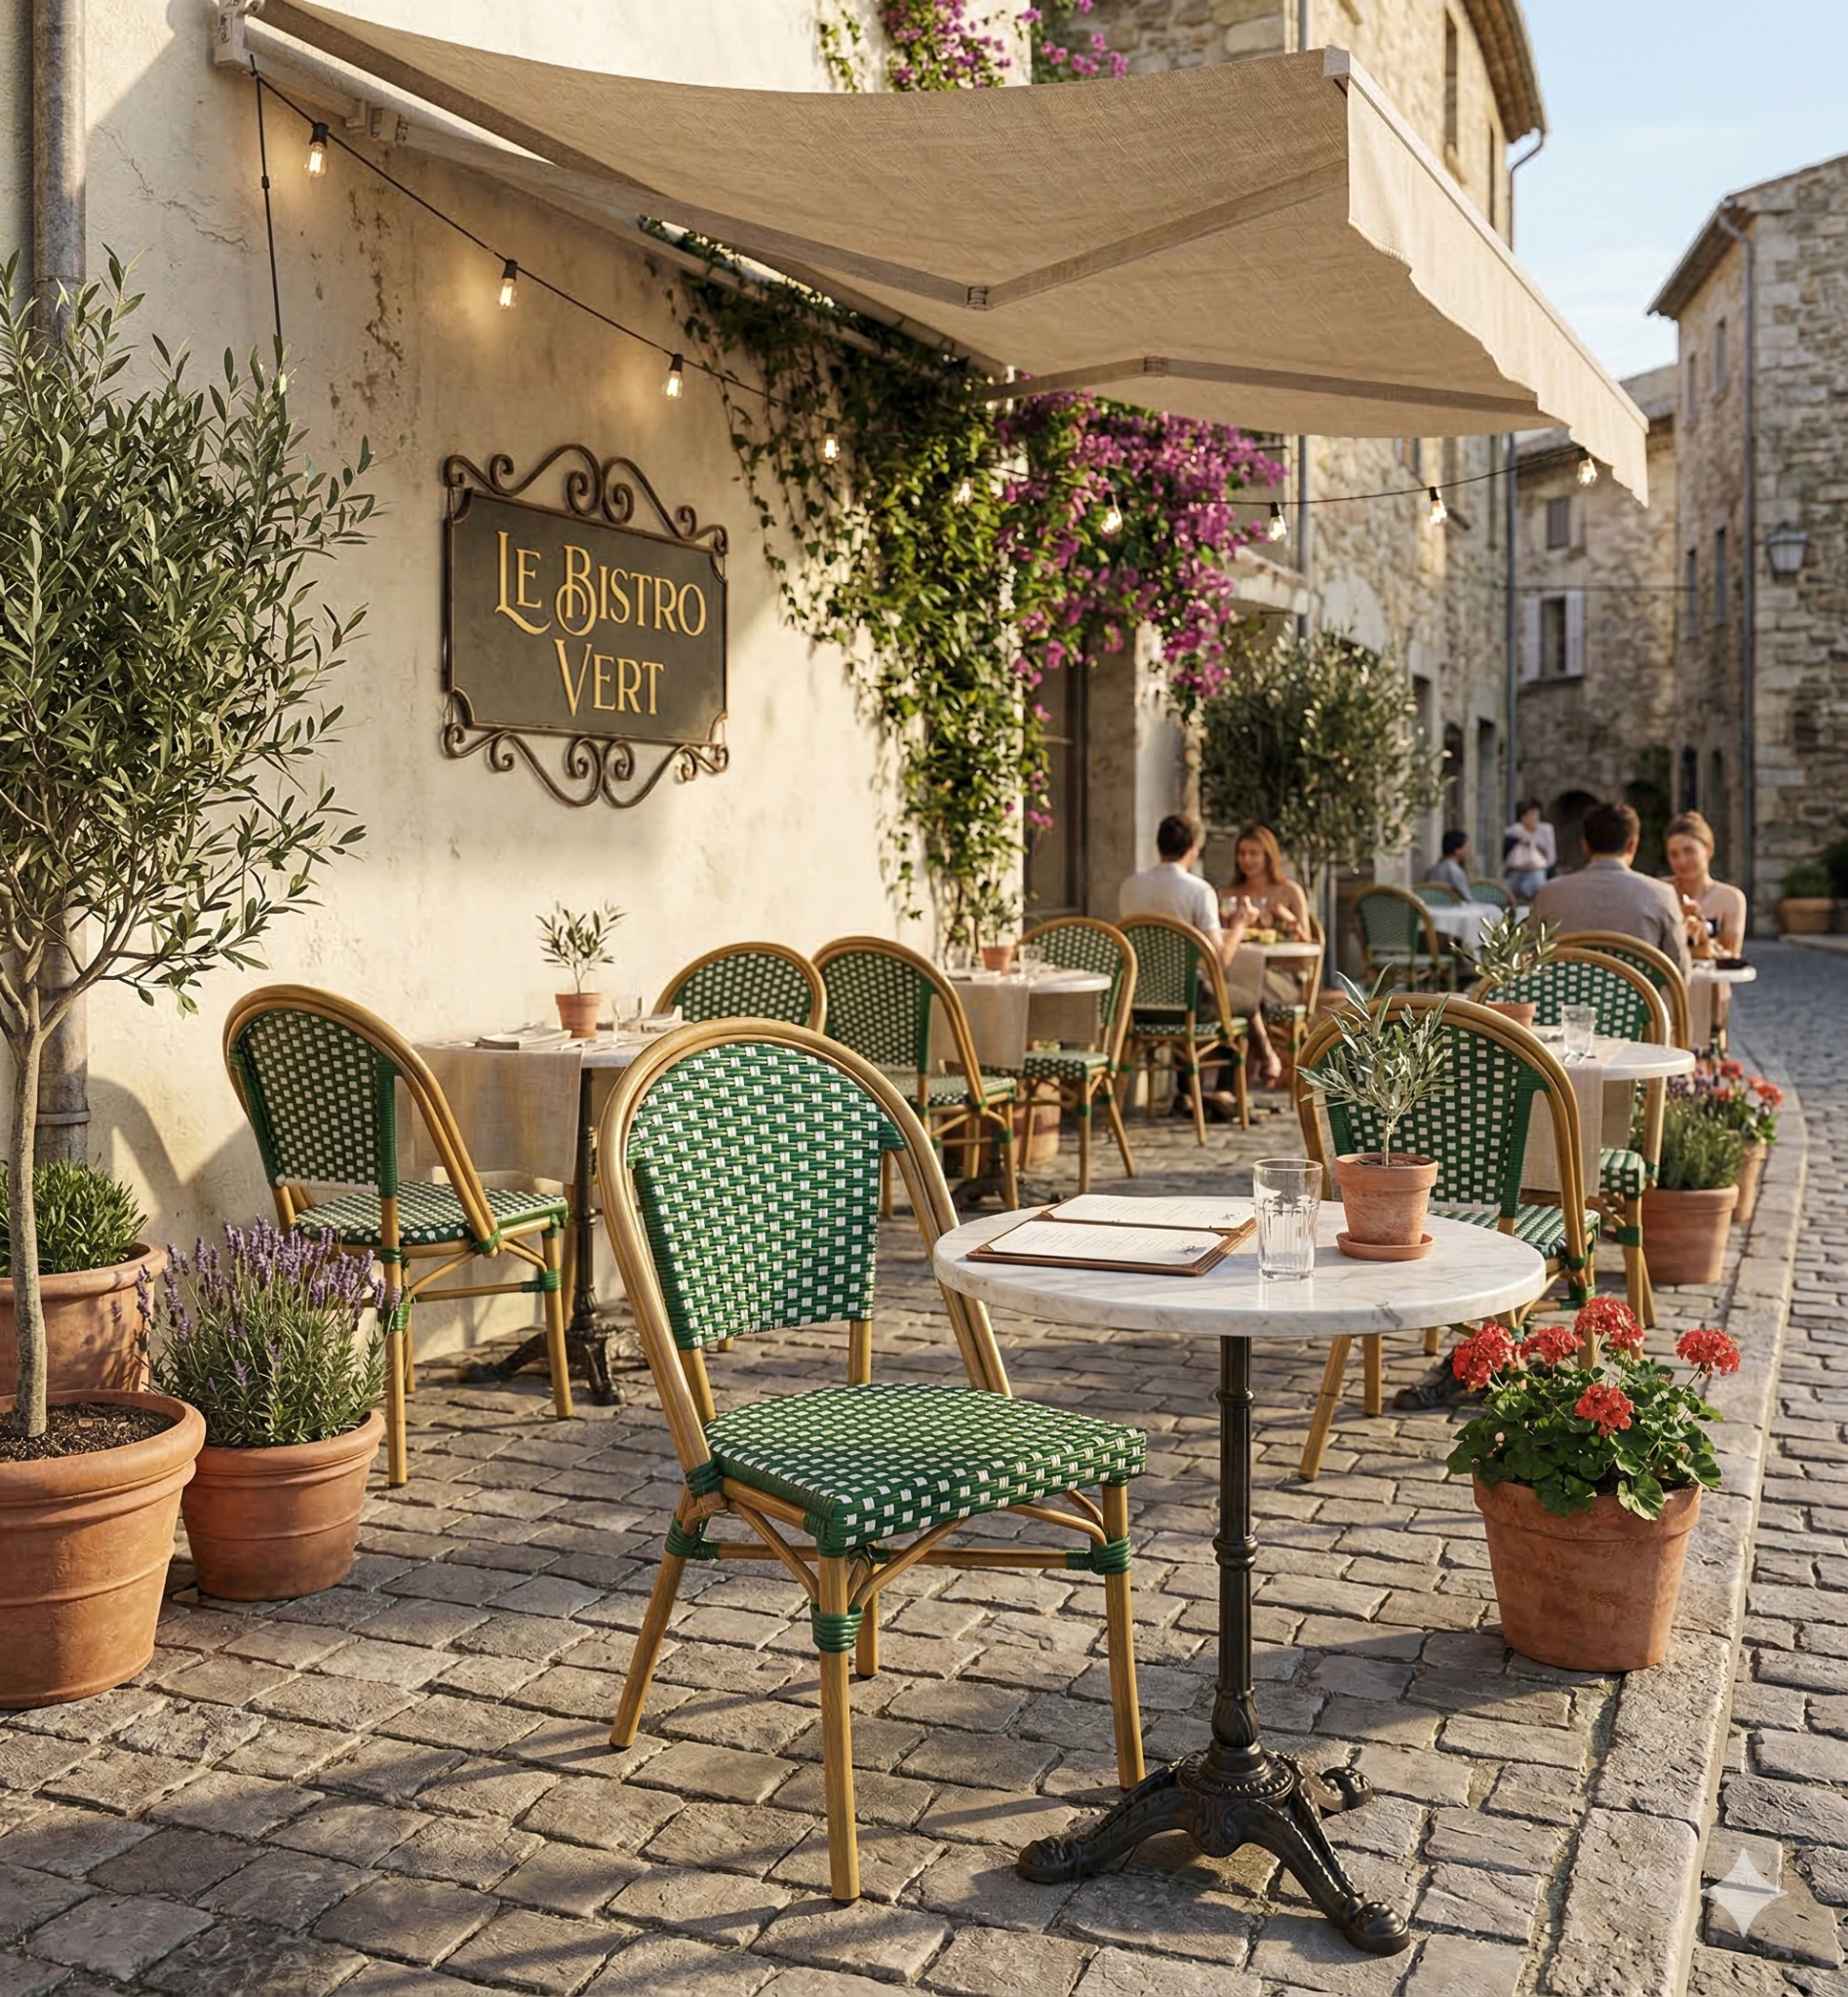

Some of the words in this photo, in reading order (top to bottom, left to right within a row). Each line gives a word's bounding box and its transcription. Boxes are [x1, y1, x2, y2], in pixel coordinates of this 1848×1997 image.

[494, 530, 552, 635] LE
[555, 544, 707, 637] BISTRO
[553, 638, 665, 717] VERT
